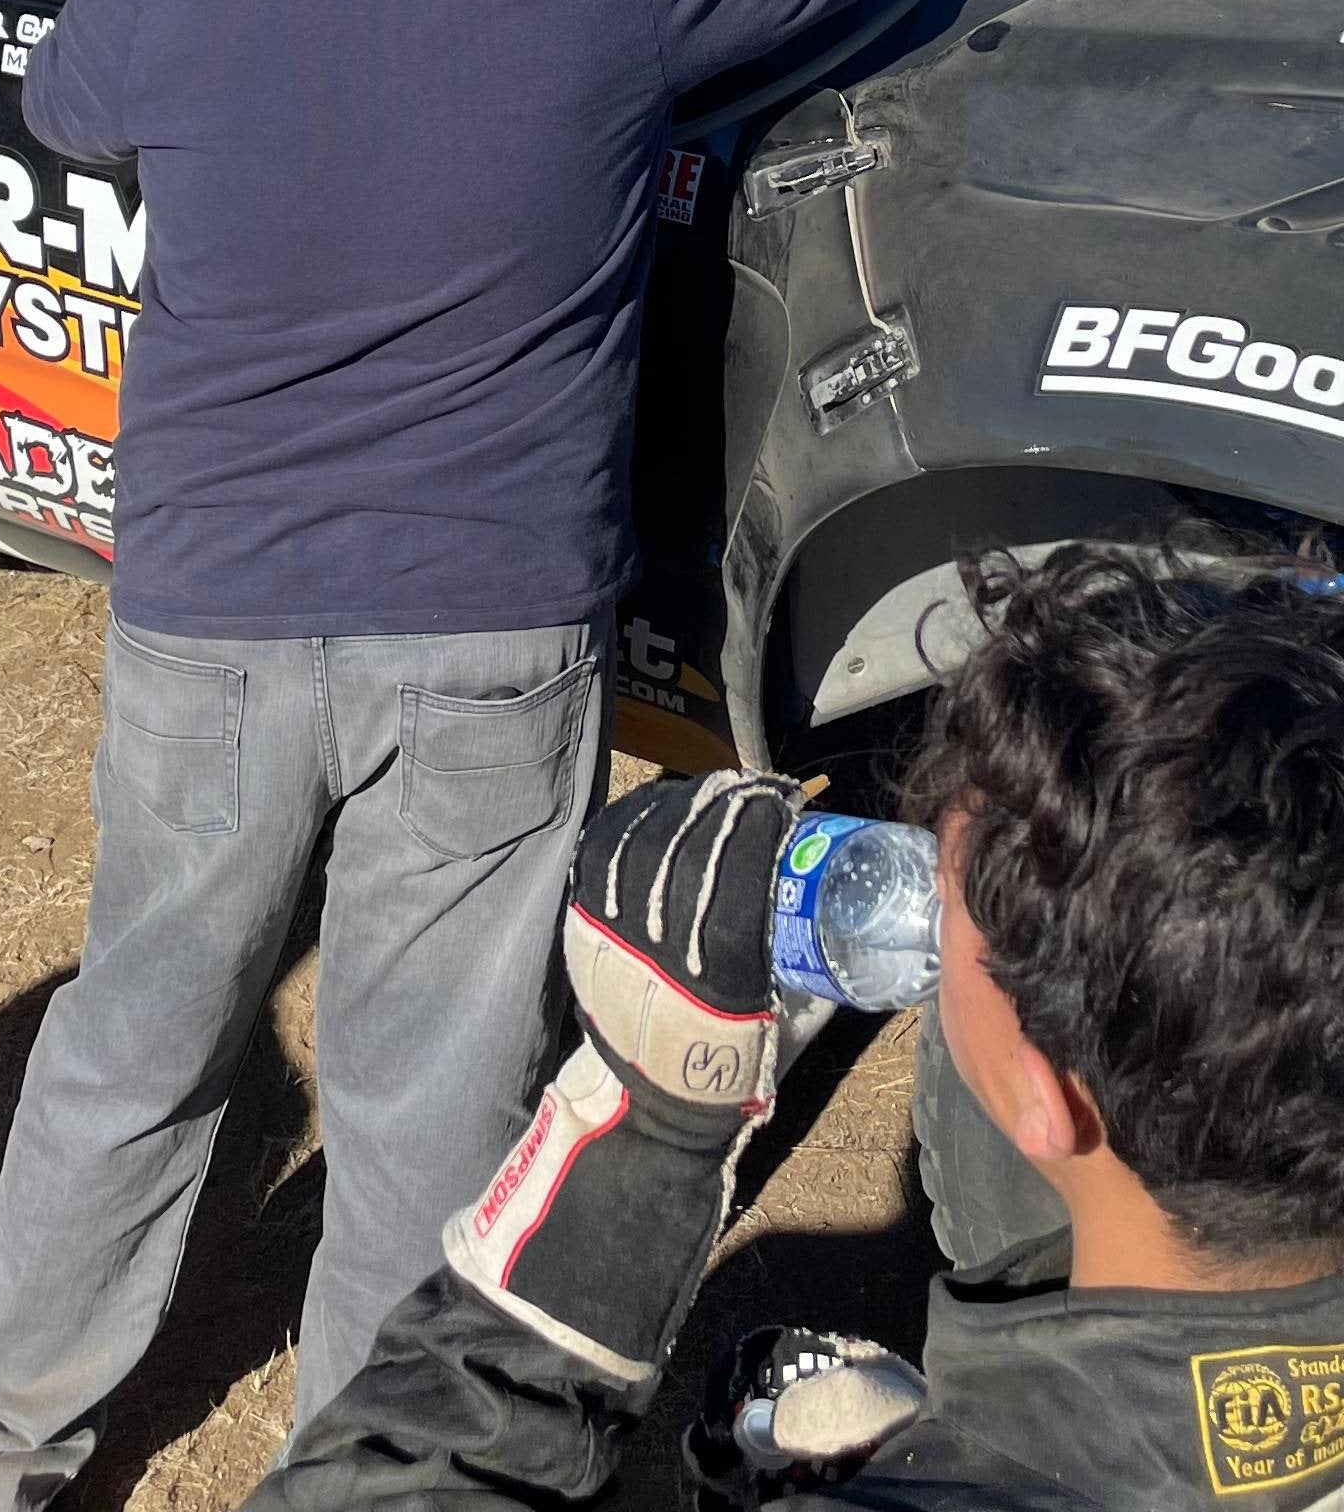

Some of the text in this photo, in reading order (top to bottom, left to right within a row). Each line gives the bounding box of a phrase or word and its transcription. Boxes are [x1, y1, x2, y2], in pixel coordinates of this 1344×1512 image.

[482, 1103, 553, 1225] SIMPSON
[1226, 1455, 1276, 1480] Year
[1285, 1448, 1305, 1469] of
